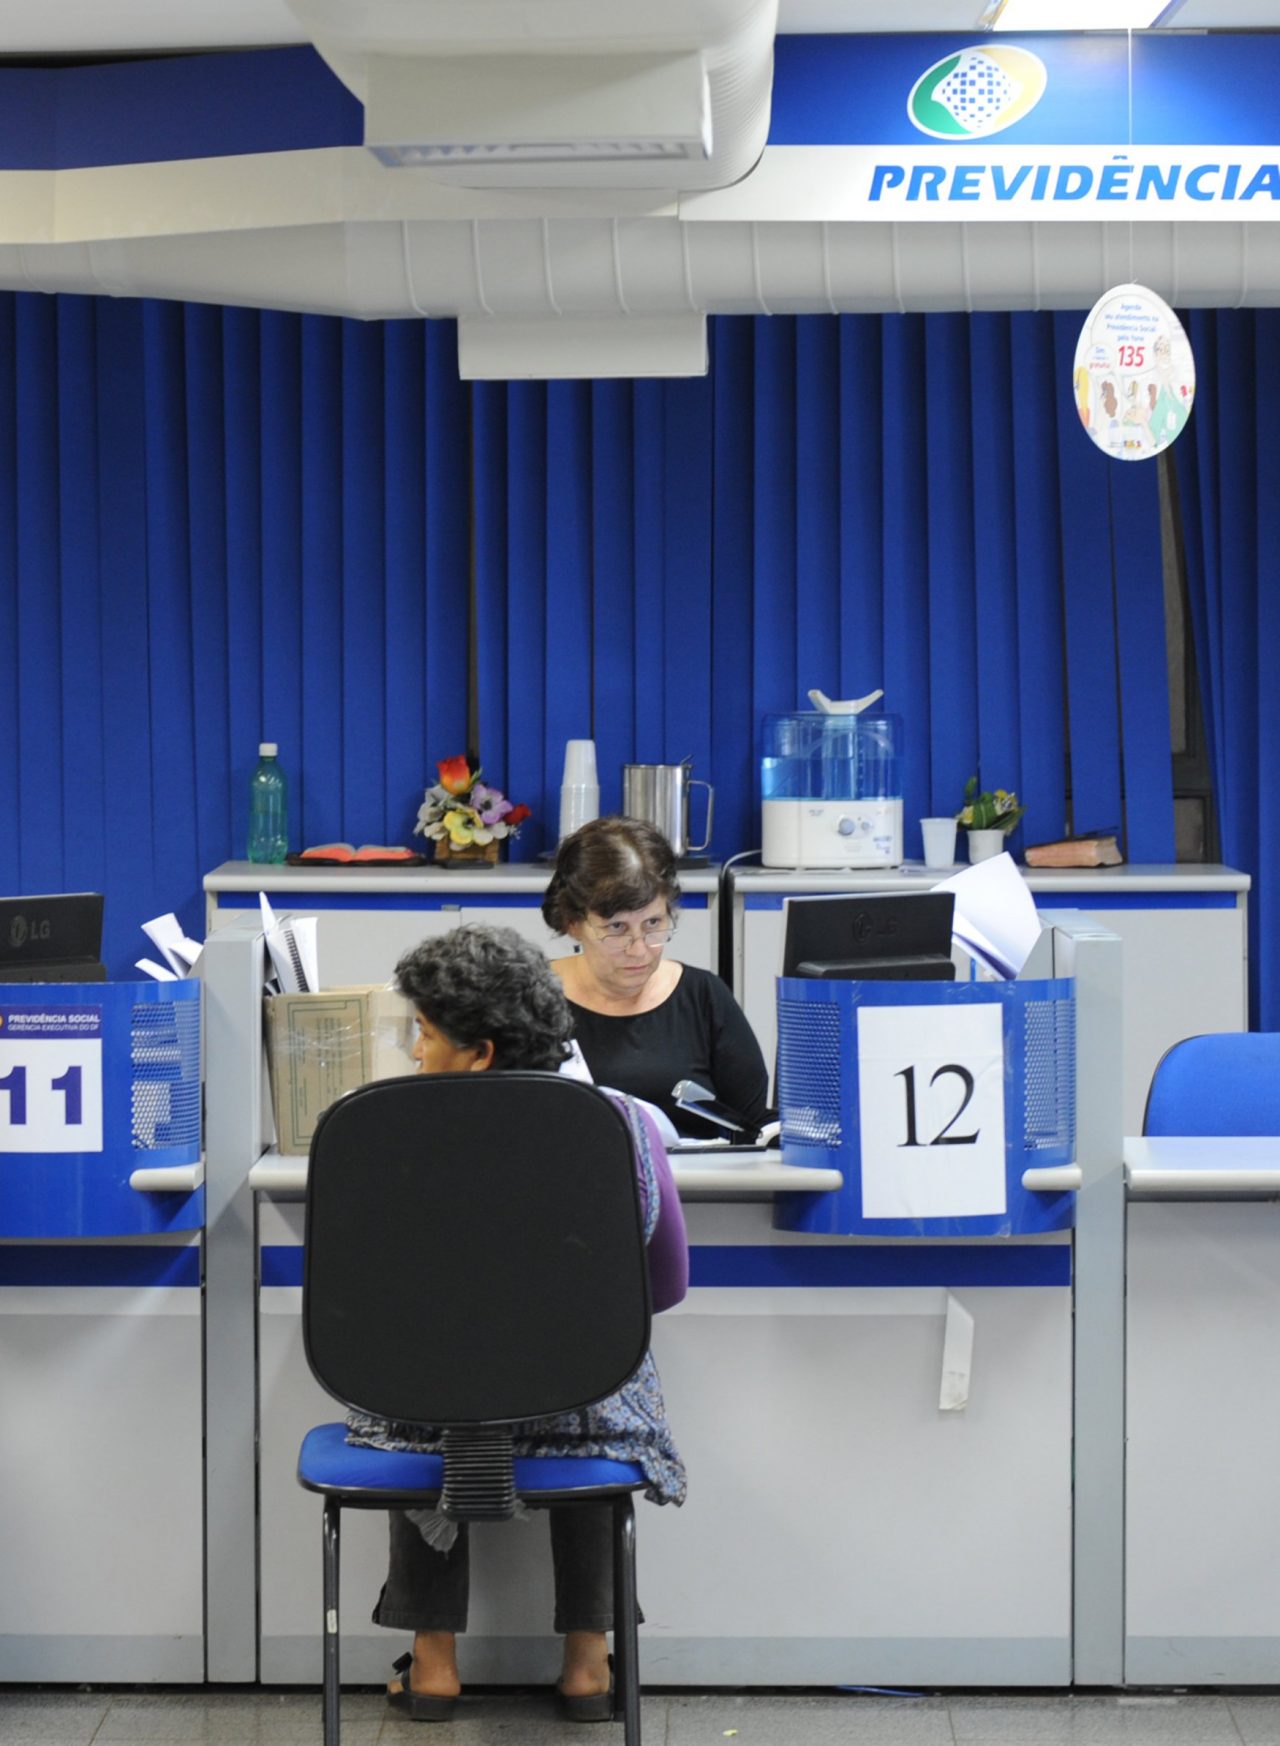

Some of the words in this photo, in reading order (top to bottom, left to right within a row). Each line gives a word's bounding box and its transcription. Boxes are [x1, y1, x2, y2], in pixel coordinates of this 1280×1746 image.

[867, 155, 1280, 201] PREVIDÊNCIA
[1118, 345, 1145, 367] 135
[30, 919, 51, 940] LG
[8, 1013, 66, 1023] PREVIDÊNCIA
[68, 1014, 100, 1023] SOCIAL
[893, 1063, 981, 1147] 12
